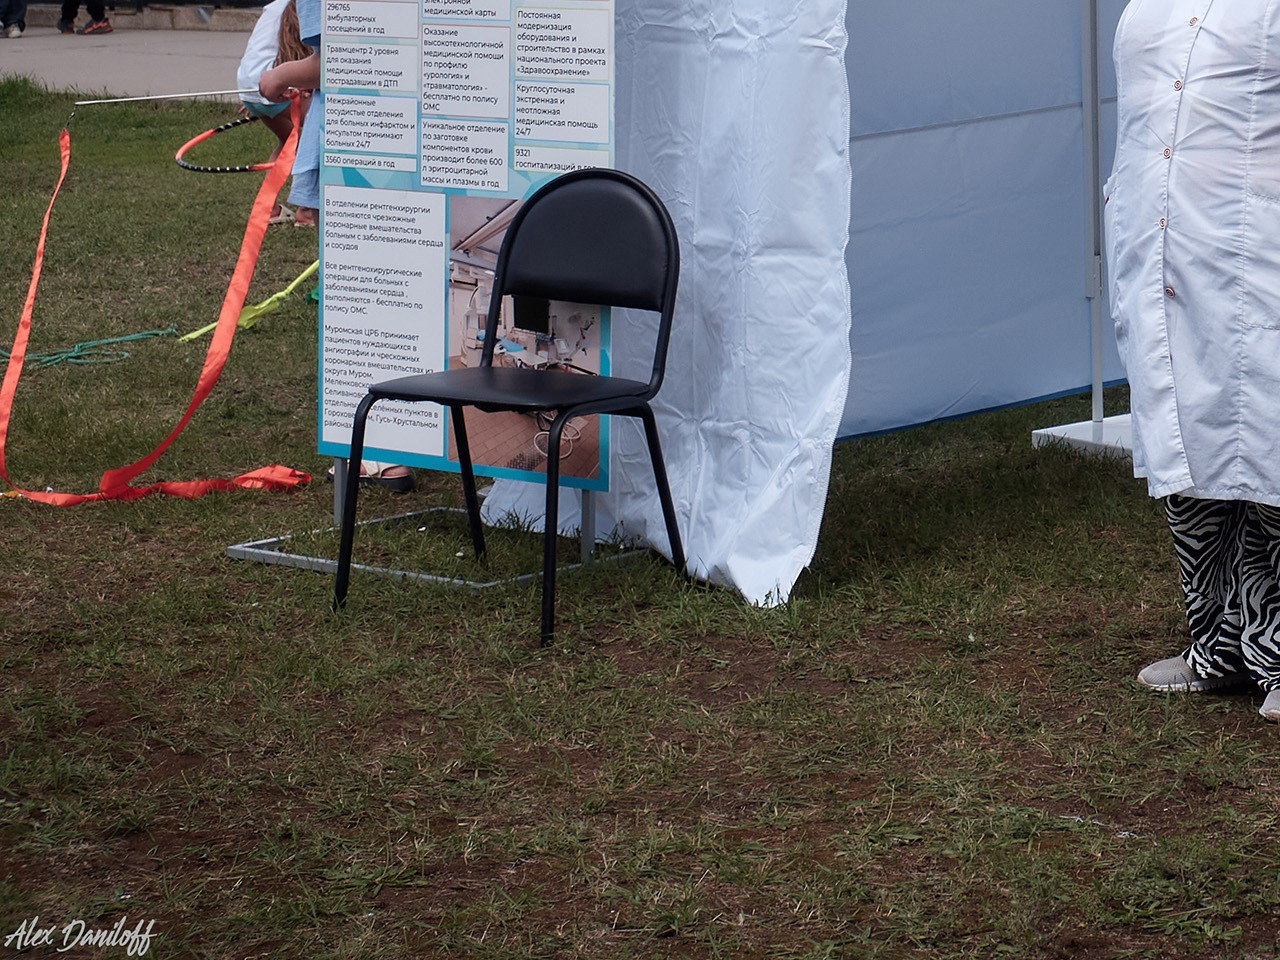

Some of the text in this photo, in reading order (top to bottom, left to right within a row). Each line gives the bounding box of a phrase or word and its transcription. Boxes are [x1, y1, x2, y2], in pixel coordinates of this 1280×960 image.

[327, 3, 351, 11] 296765
[327, 14, 376, 23] амбулаторных
[518, 11, 561, 19] Постоянная
[327, 25, 366, 33] посещений
[518, 23, 571, 31] модернизация
[424, 28, 458, 36] Оказание
[517, 33, 570, 42] оборудования
[424, 40, 504, 49] высокотехнологичной
[517, 45, 570, 53] строительство
[327, 45, 368, 54] Травмцентр
[424, 50, 472, 58] медицинской
[434, 61, 468, 69] профилю
[517, 56, 606, 66] национального проекта
[517, 66, 590, 76] «Здравоохранение»
[326, 78, 399, 88] пострадавшим ДТП
[424, 83, 483, 91] «травматология»
[517, 84, 575, 94] Круглосуточная
[326, 97, 376, 106] Межрайонные
[423, 92, 460, 101] бесплатно
[472, 96, 498, 105] полису
[516, 96, 558, 104] экстренная
[423, 103, 440, 111] ОМС
[326, 109, 404, 118] сосудистые отделения
[340, 118, 368, 127] больных
[370, 122, 409, 130] инфарктом
[423, 121, 505, 133] Уникальное отделение
[516, 118, 598, 129] медицинская помощь
[326, 130, 403, 140] инсультом принимают
[516, 128, 531, 136] 24/7
[433, 134, 468, 142] заготовке
[326, 138, 371, 148] больных 24/7
[423, 144, 469, 152] компонентов
[516, 149, 530, 157] 9321
[326, 156, 341, 164] 3560
[342, 157, 376, 166] операций
[423, 155, 503, 166] производит более 600
[516, 160, 575, 171] госпитализаций
[428, 166, 488, 176] эритроцитарной
